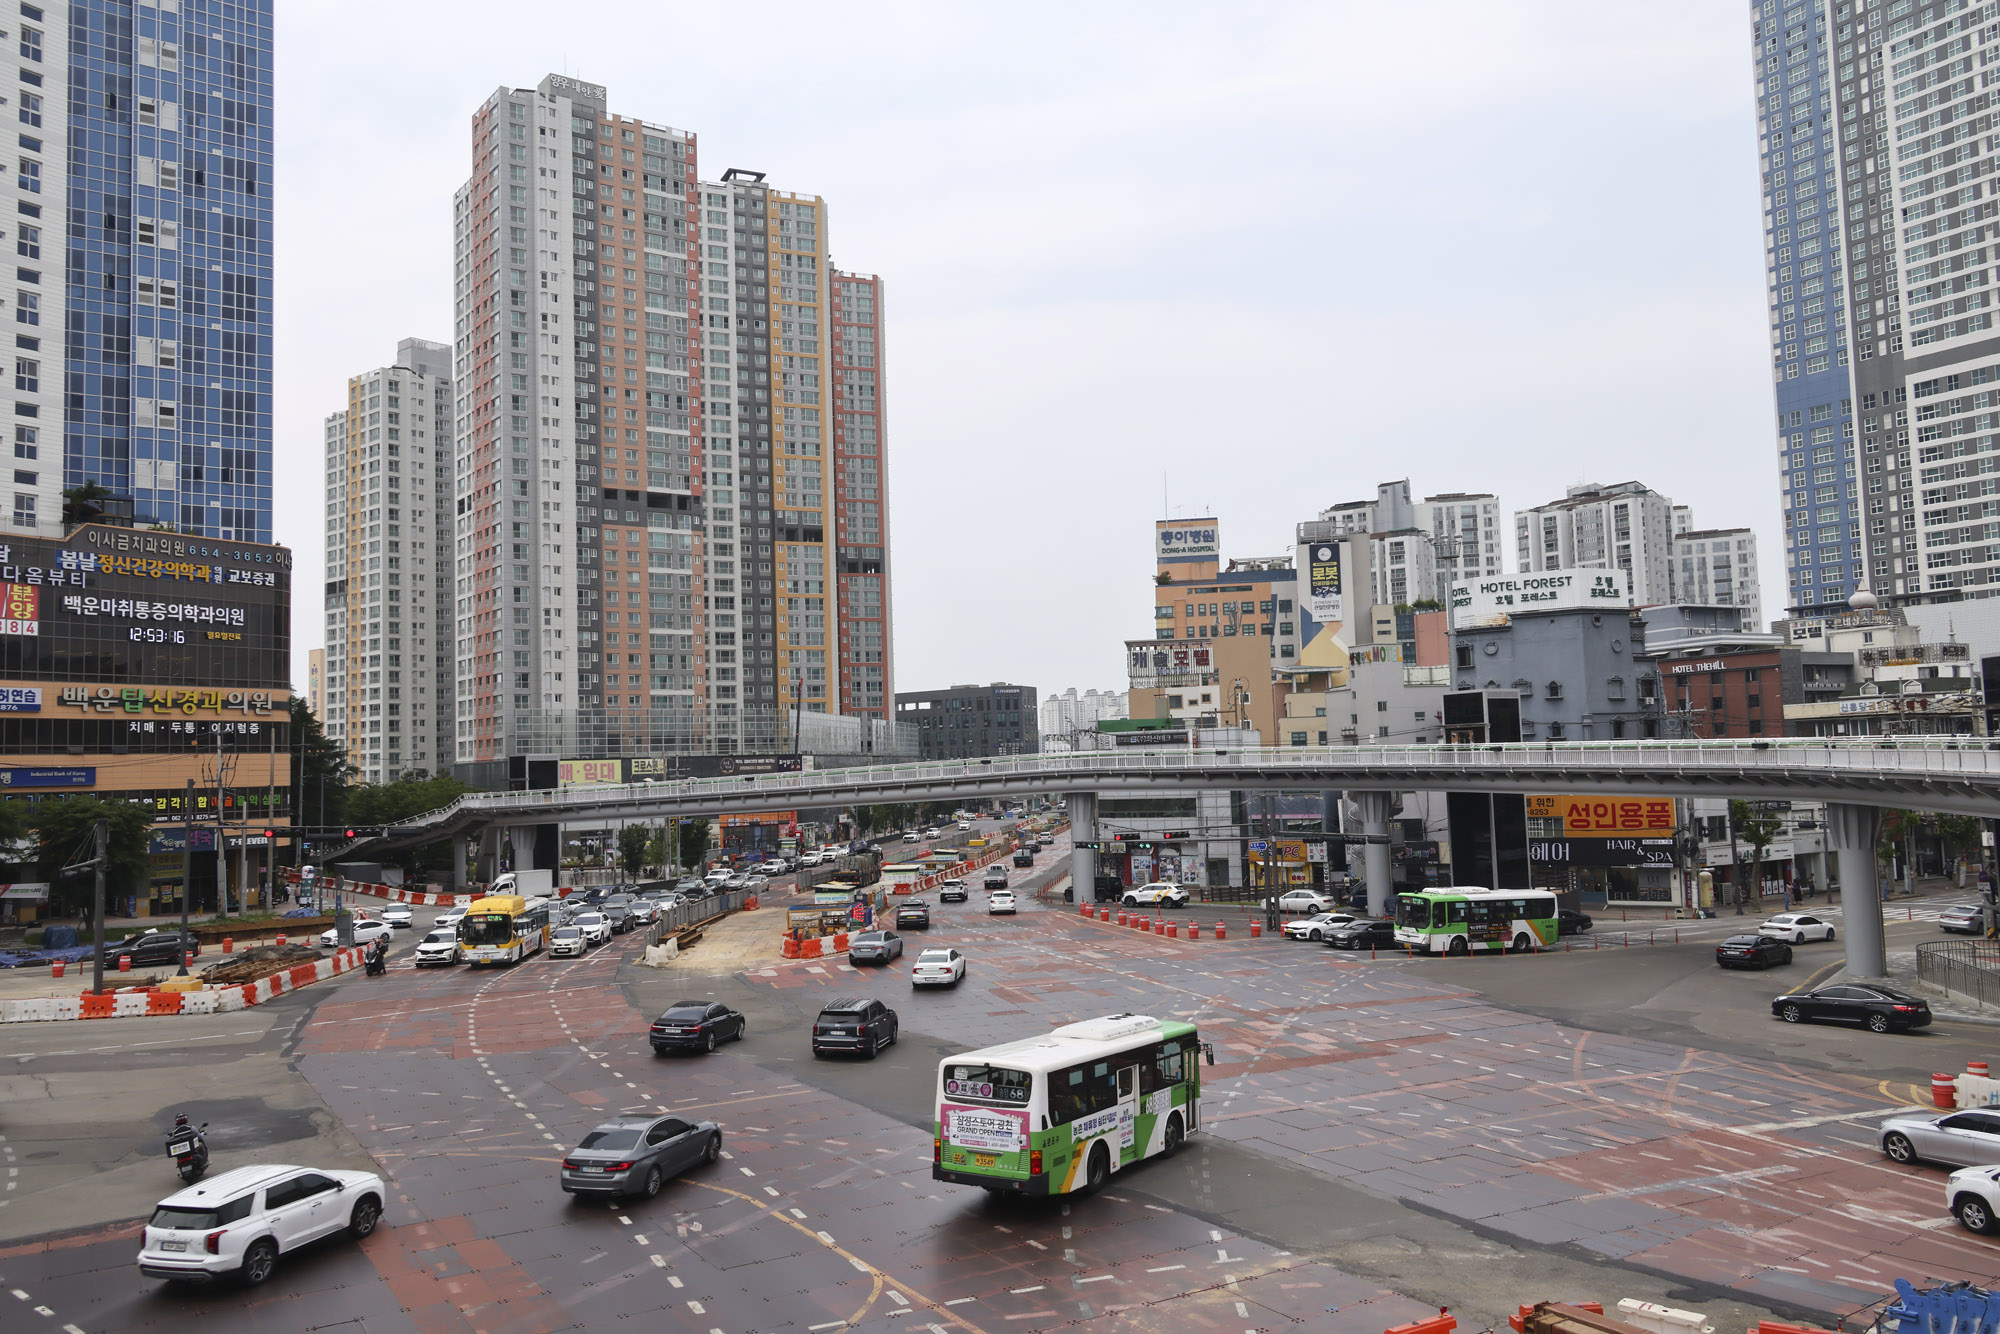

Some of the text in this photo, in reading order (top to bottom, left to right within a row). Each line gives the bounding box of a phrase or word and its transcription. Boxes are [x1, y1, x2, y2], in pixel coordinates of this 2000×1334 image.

[1161, 529, 1215, 545] 동아병원
[88, 530, 186, 556] 이사금치과의원
[189, 545, 273, 564] 654-3652
[1187, 545, 1215, 553] HOSPITAL
[60, 550, 98, 572] 봄날
[97, 554, 212, 582] 정신건강의학과
[1312, 566, 1338, 580] 로봇
[3, 565, 86, 588] 다옴뷰티
[228, 569, 276, 586] 교보증권
[1480, 576, 1573, 593] HOTEL FOREST
[1452, 587, 1470, 597] OTEL
[1495, 591, 1558, 605] 호텔 포레스트
[10, 584, 35, 619] 분양
[64, 595, 244, 625] 백운마취통증의학과의원
[130, 627, 185, 644] 12:53:16
[1372, 646, 1403, 662] MOTEL
[1672, 664, 1694, 673] HOTEL
[62, 686, 273, 716] 백운탑신경과의원
[129, 721, 260, 734] 치매 두통 어지럼증
[157, 796, 207, 809] 감각합
[1536, 798, 1554, 808] 위한
[1568, 802, 1671, 829] 성인용품
[1283, 845, 1301, 858] PC
[1530, 842, 1570, 861] 헤어
[1607, 839, 1635, 851] HAIR
[1636, 846, 1645, 856] &
[1647, 851, 1673, 862] SPA
[1010, 1089, 1024, 1099] 68
[956, 1115, 996, 1129] 삼성스토어
[957, 1126, 996, 1137] GRAND OPEN
